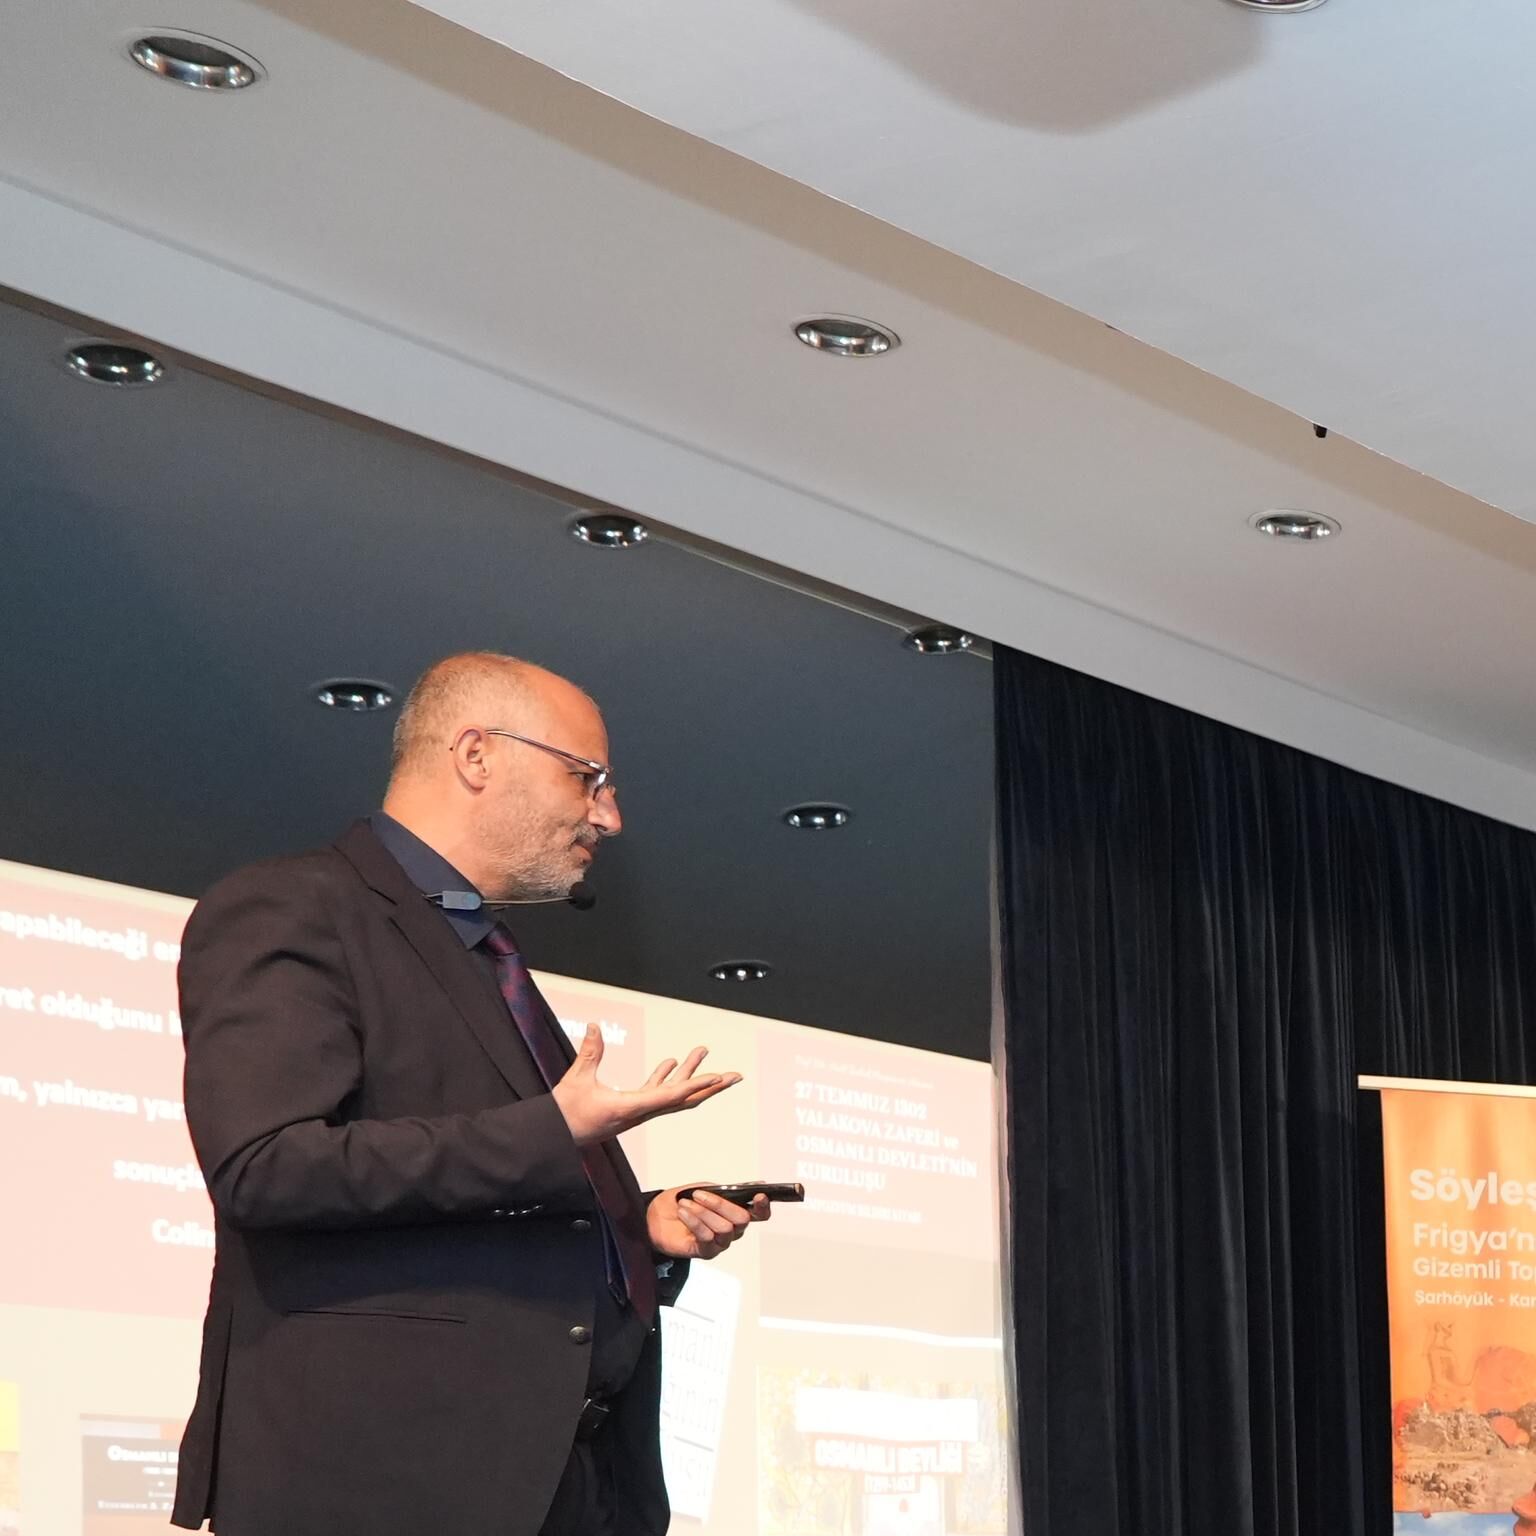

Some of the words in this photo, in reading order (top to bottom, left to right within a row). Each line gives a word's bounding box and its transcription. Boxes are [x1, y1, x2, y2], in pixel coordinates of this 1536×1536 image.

[40, 991, 163, 1032] olduğunu
[33, 1079, 138, 1114] yalnızca
[814, 1084, 891, 1114] TEMMUZ
[796, 1134, 875, 1163] OSMANLI
[1413, 1257, 1502, 1280] Gizemli
[1414, 1289, 1494, 1308] Şarhöyük
